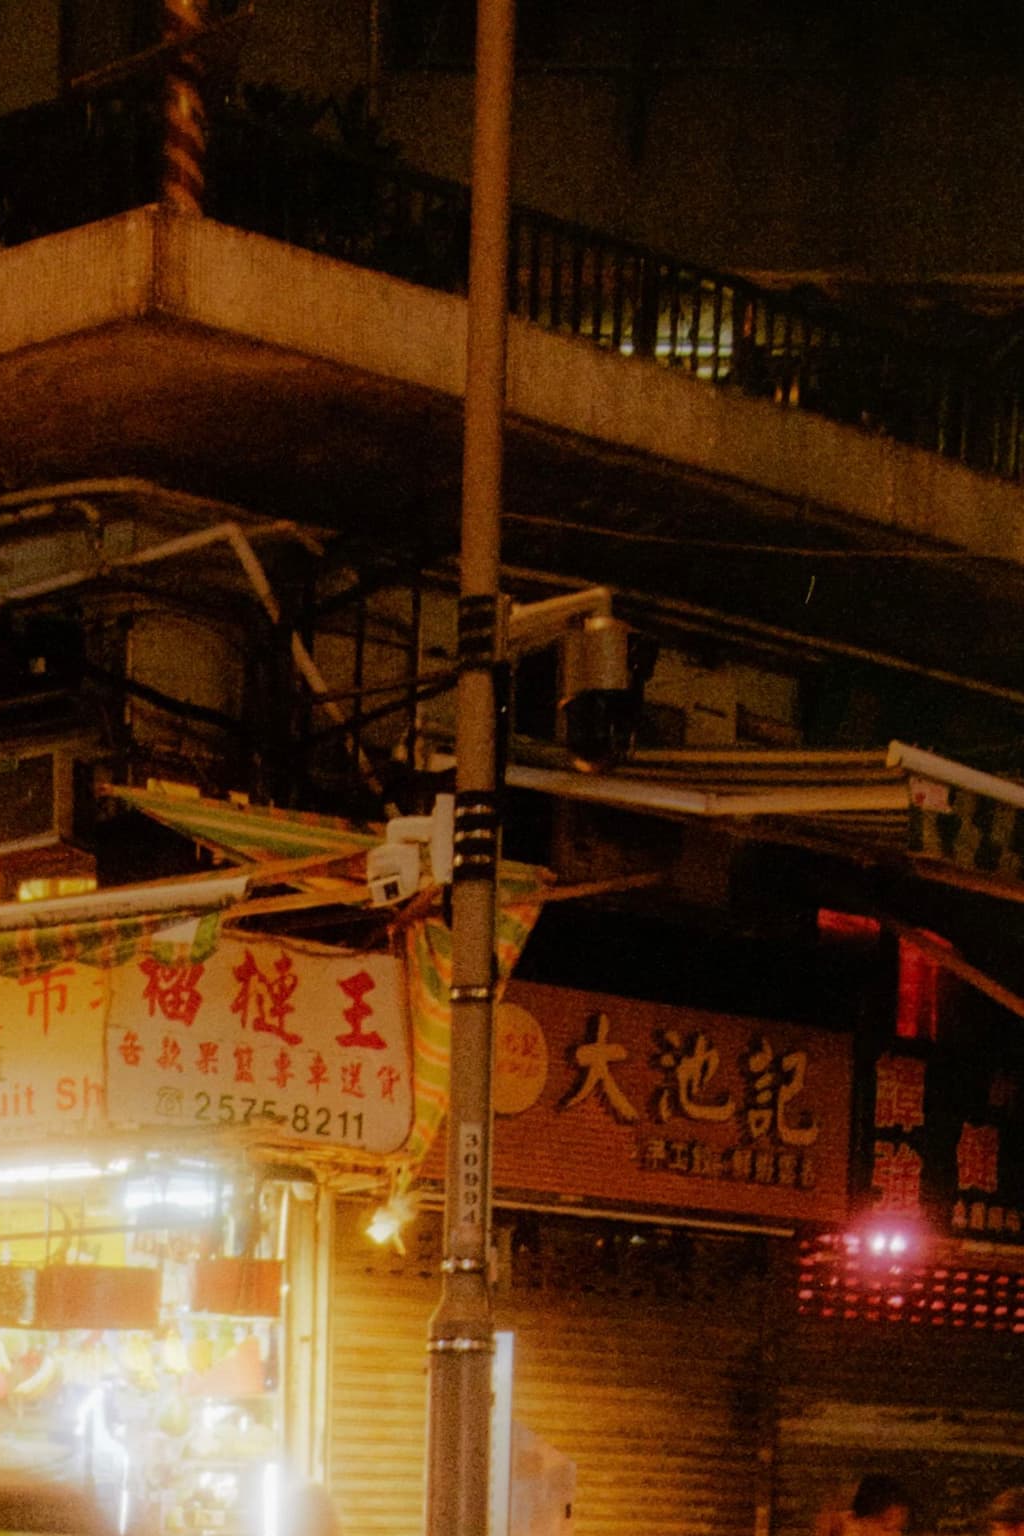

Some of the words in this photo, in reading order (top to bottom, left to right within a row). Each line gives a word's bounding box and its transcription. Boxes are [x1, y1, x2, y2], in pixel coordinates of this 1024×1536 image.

[138, 951, 387, 1050] 榴槤王
[194, 1092, 365, 1140] 2575-8211
[560, 1012, 820, 1146] 大池記
